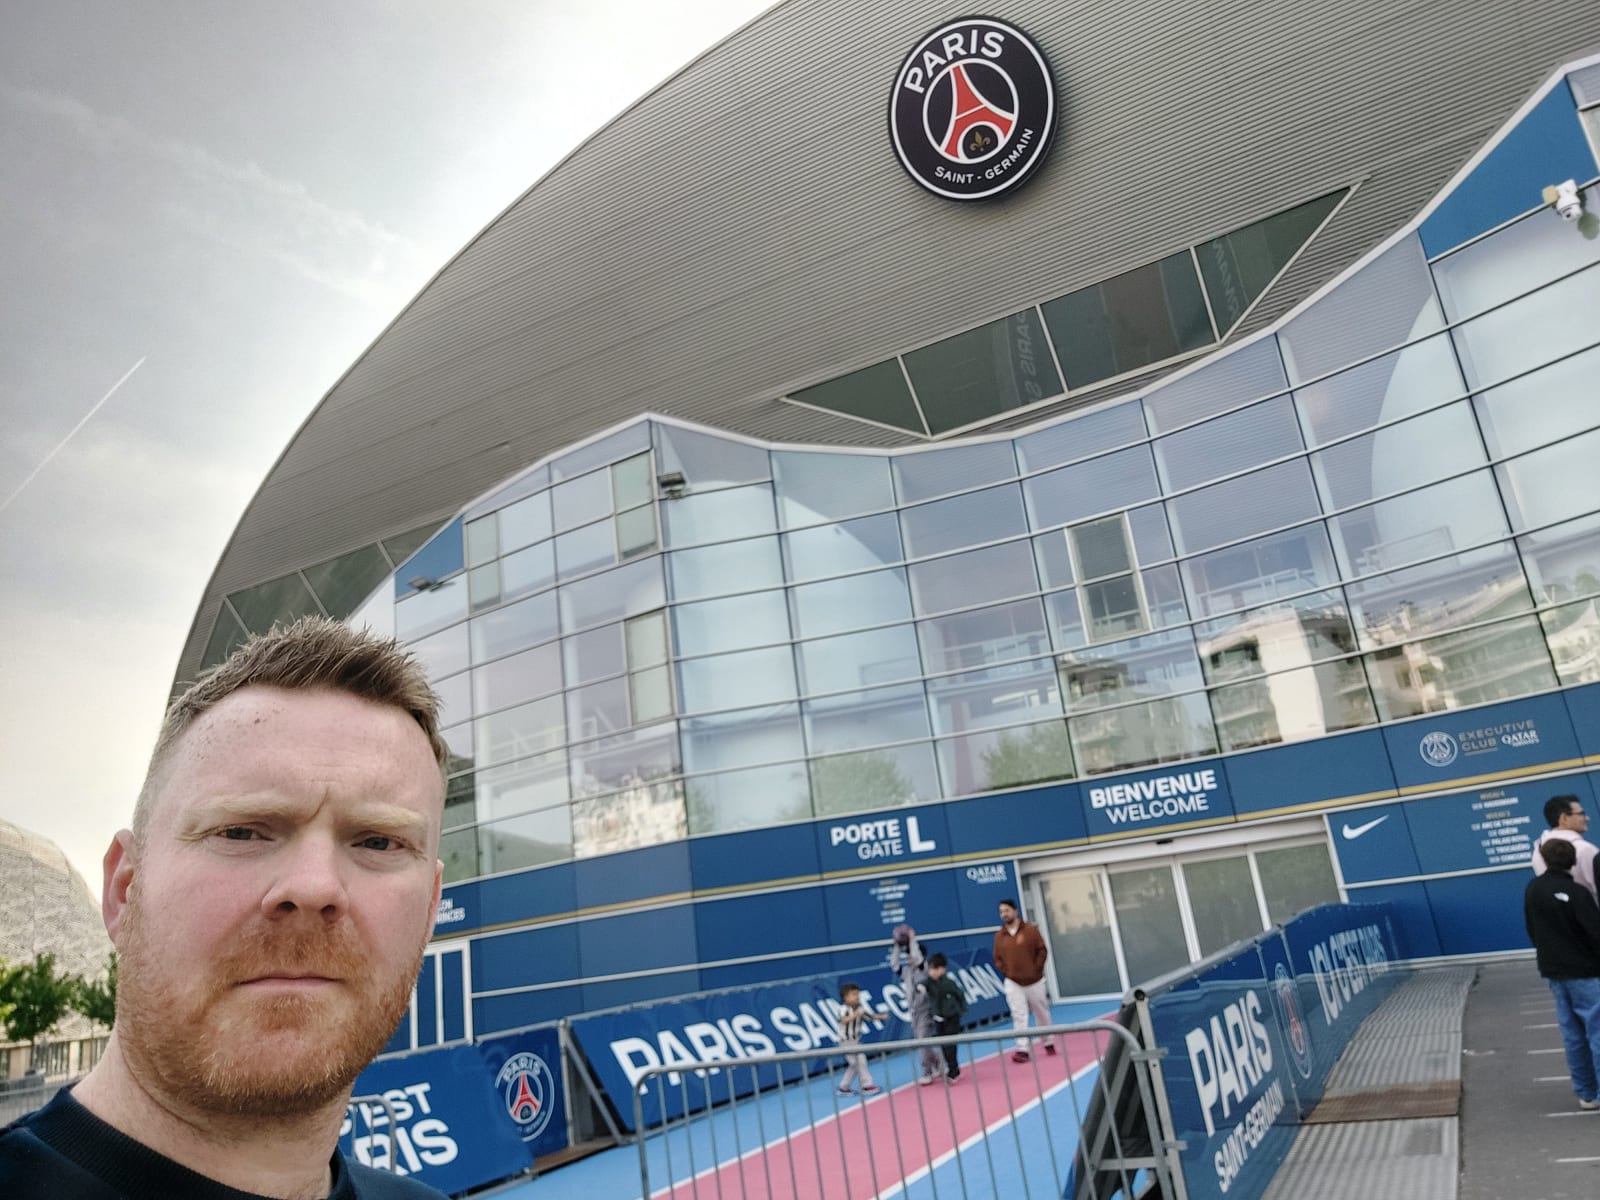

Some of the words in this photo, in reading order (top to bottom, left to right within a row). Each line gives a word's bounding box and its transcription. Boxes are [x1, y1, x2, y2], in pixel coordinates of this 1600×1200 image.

[904, 29, 1005, 94] PARIS
[935, 165, 975, 185] SAINT
[984, 127, 1034, 180] GERMAIN
[1458, 720, 1535, 741] EXECUTIVE
[1461, 736, 1497, 752] CLUB
[1501, 729, 1538, 747] QATAR
[1089, 768, 1217, 809] BIENVENUE
[1106, 793, 1209, 825] WELCOME
[830, 818, 901, 847] PORTE
[906, 816, 936, 853] L
[857, 837, 903, 861] GATE
[502, 1056, 543, 1083] PARIS
[609, 1013, 777, 1096] PARIS
[1184, 989, 1274, 1139] PARIS
[353, 1118, 459, 1176] RIS
[1214, 1079, 1285, 1193] SAINT-GERMAIN
